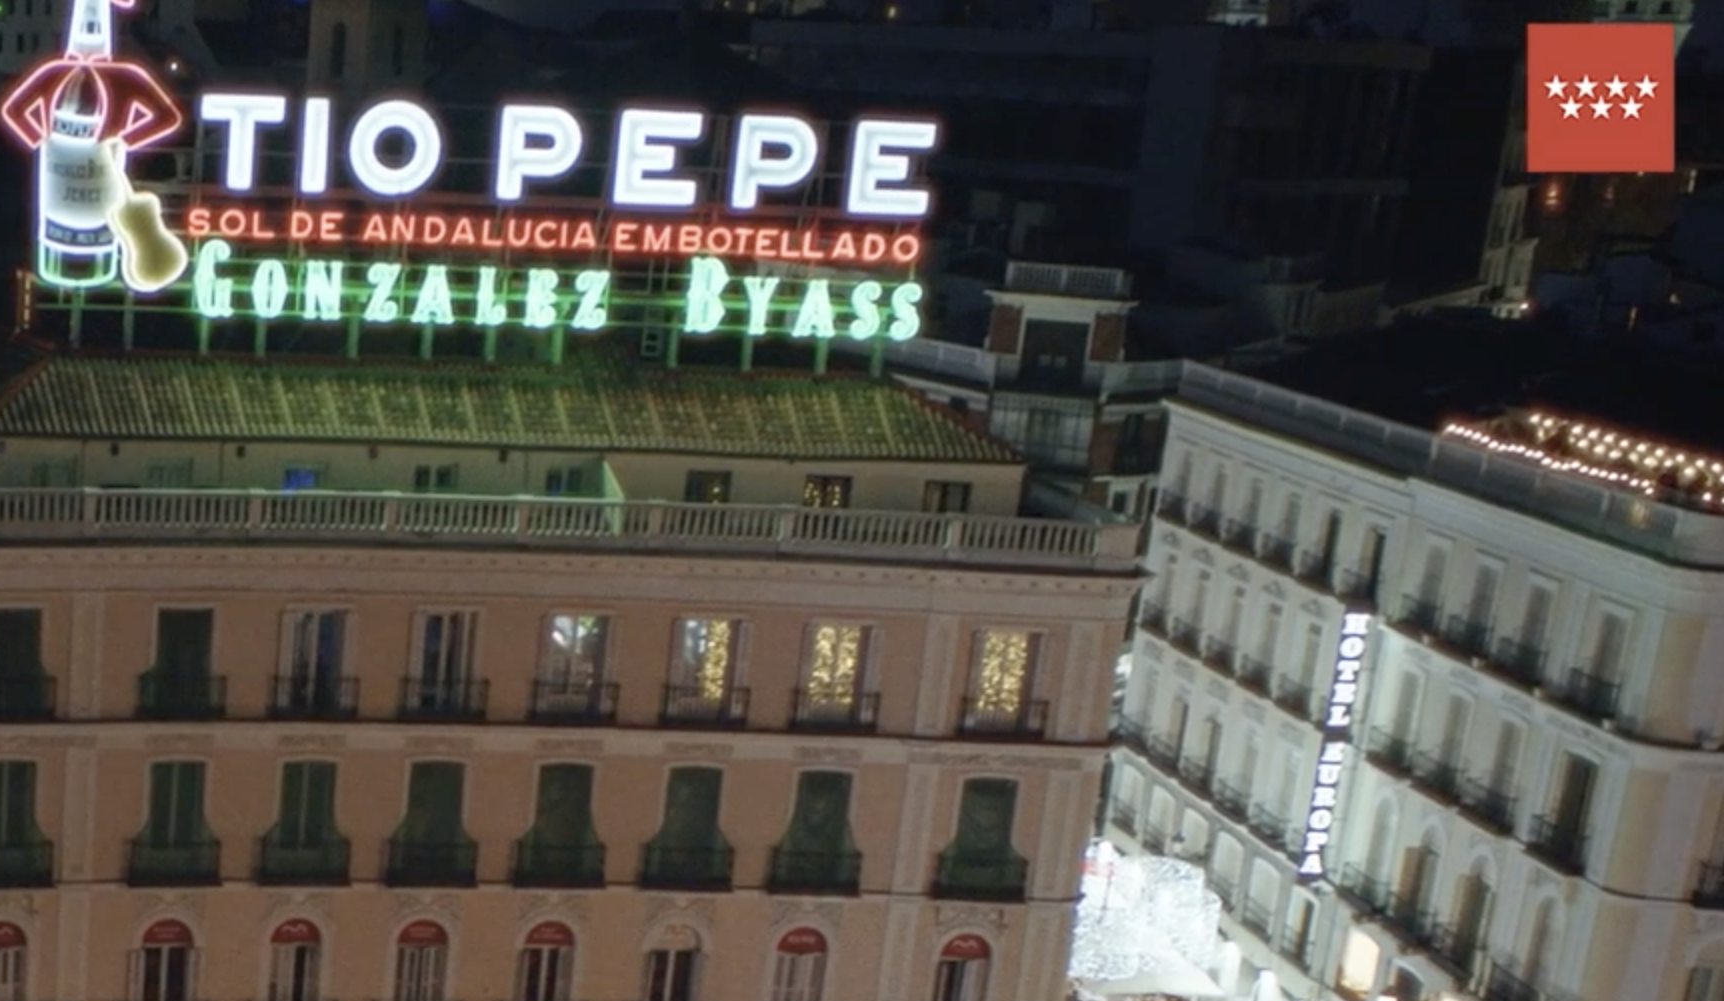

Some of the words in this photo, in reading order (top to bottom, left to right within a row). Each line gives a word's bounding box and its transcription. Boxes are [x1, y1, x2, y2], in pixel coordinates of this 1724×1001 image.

[199, 93, 443, 198] TIO
[494, 104, 938, 217] PEPE
[188, 207, 275, 240] SOL
[289, 211, 343, 242] DE
[362, 214, 597, 250] ANDALUCIA
[612, 222, 920, 261] EMBOTELLADO
[1326, 613, 1372, 727] HOTEL
[1299, 742, 1345, 874] EUROPA
